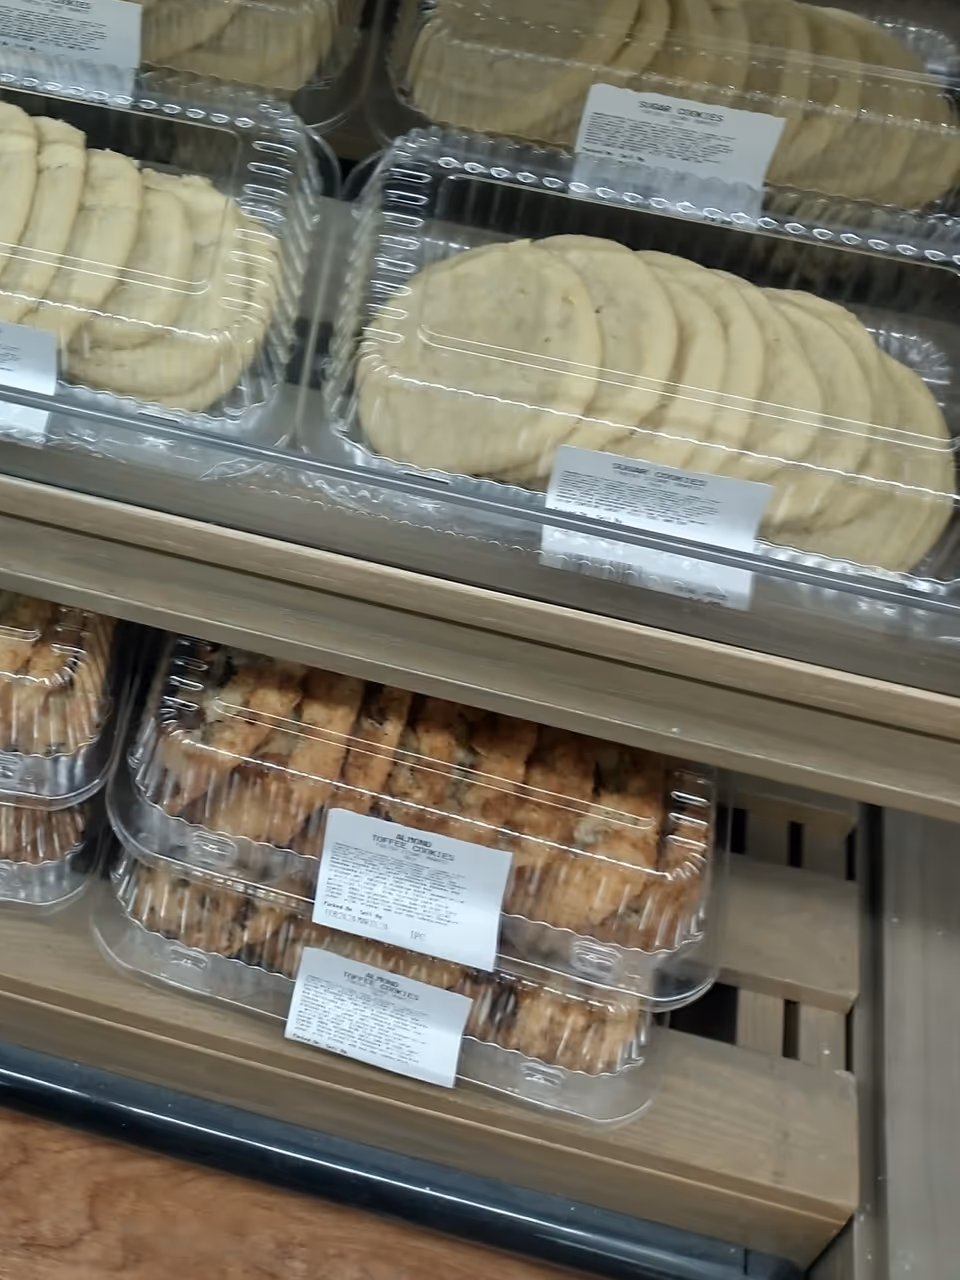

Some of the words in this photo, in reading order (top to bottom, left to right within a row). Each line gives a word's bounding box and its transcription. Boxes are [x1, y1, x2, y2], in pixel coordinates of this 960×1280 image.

[638, 100, 672, 112] SUGAR
[678, 107, 725, 123] COOKIES
[611, 462, 649, 476] SUGAR
[655, 471, 708, 487] COOKIES
[372, 833, 407, 849] TOFFEE
[411, 844, 455, 862] COOKIES
[395, 833, 433, 848] ALMOND
[343, 971, 375, 986] TOFFEE
[380, 983, 419, 1001] COOKIES
[365, 972, 399, 988] ALMOND
